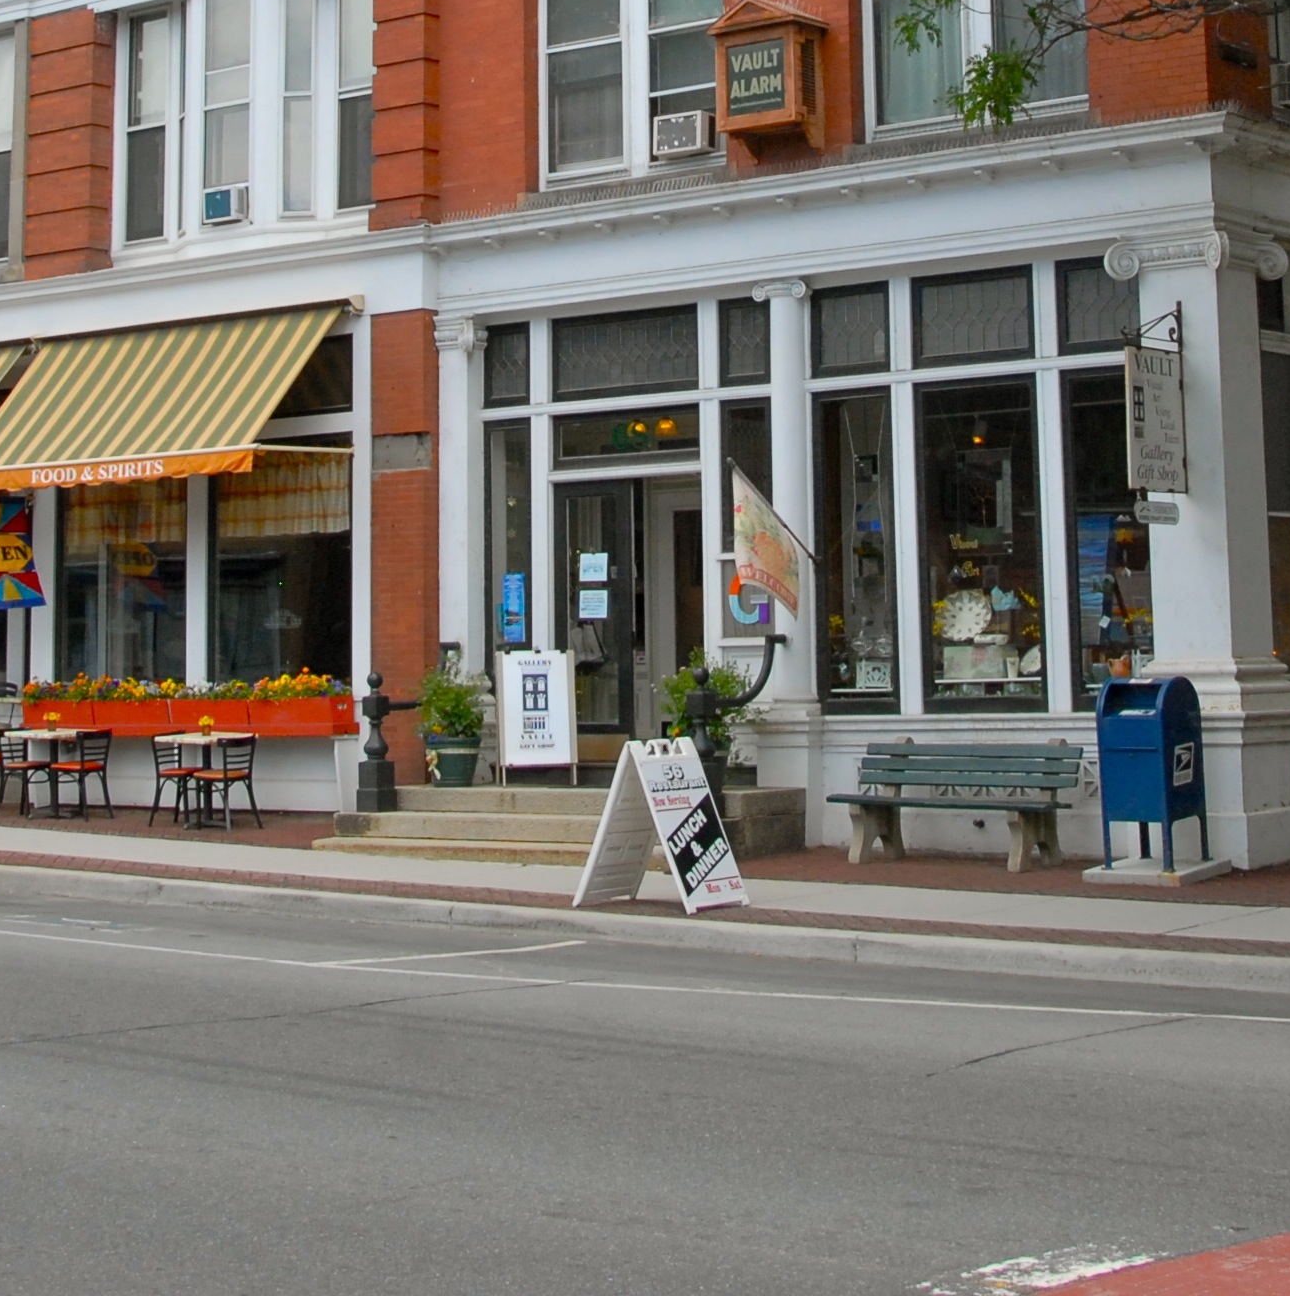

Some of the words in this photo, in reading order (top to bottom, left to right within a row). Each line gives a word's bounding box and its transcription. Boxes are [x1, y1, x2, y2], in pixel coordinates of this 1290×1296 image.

[731, 48, 780, 73] VAULT
[730, 73, 782, 99] ALARM
[1134, 354, 1174, 377] VAULT
[1140, 444, 1175, 465] Gallery
[31, 467, 77, 484] FOOD
[80, 467, 94, 481] &
[97, 459, 164, 480] SPIRITS
[1137, 464, 1155, 484] Gift
[1157, 466, 1179, 486] Shop
[661, 763, 685, 780] 56
[648, 777, 708, 792] Restaurant
[652, 796, 666, 807] Now
[667, 795, 692, 808] Serving
[668, 808, 708, 855] LUNCH
[690, 840, 704, 857] &
[685, 837, 728, 889] DINNER
[706, 883, 722, 893] Mon
[728, 881, 742, 890] Sat
